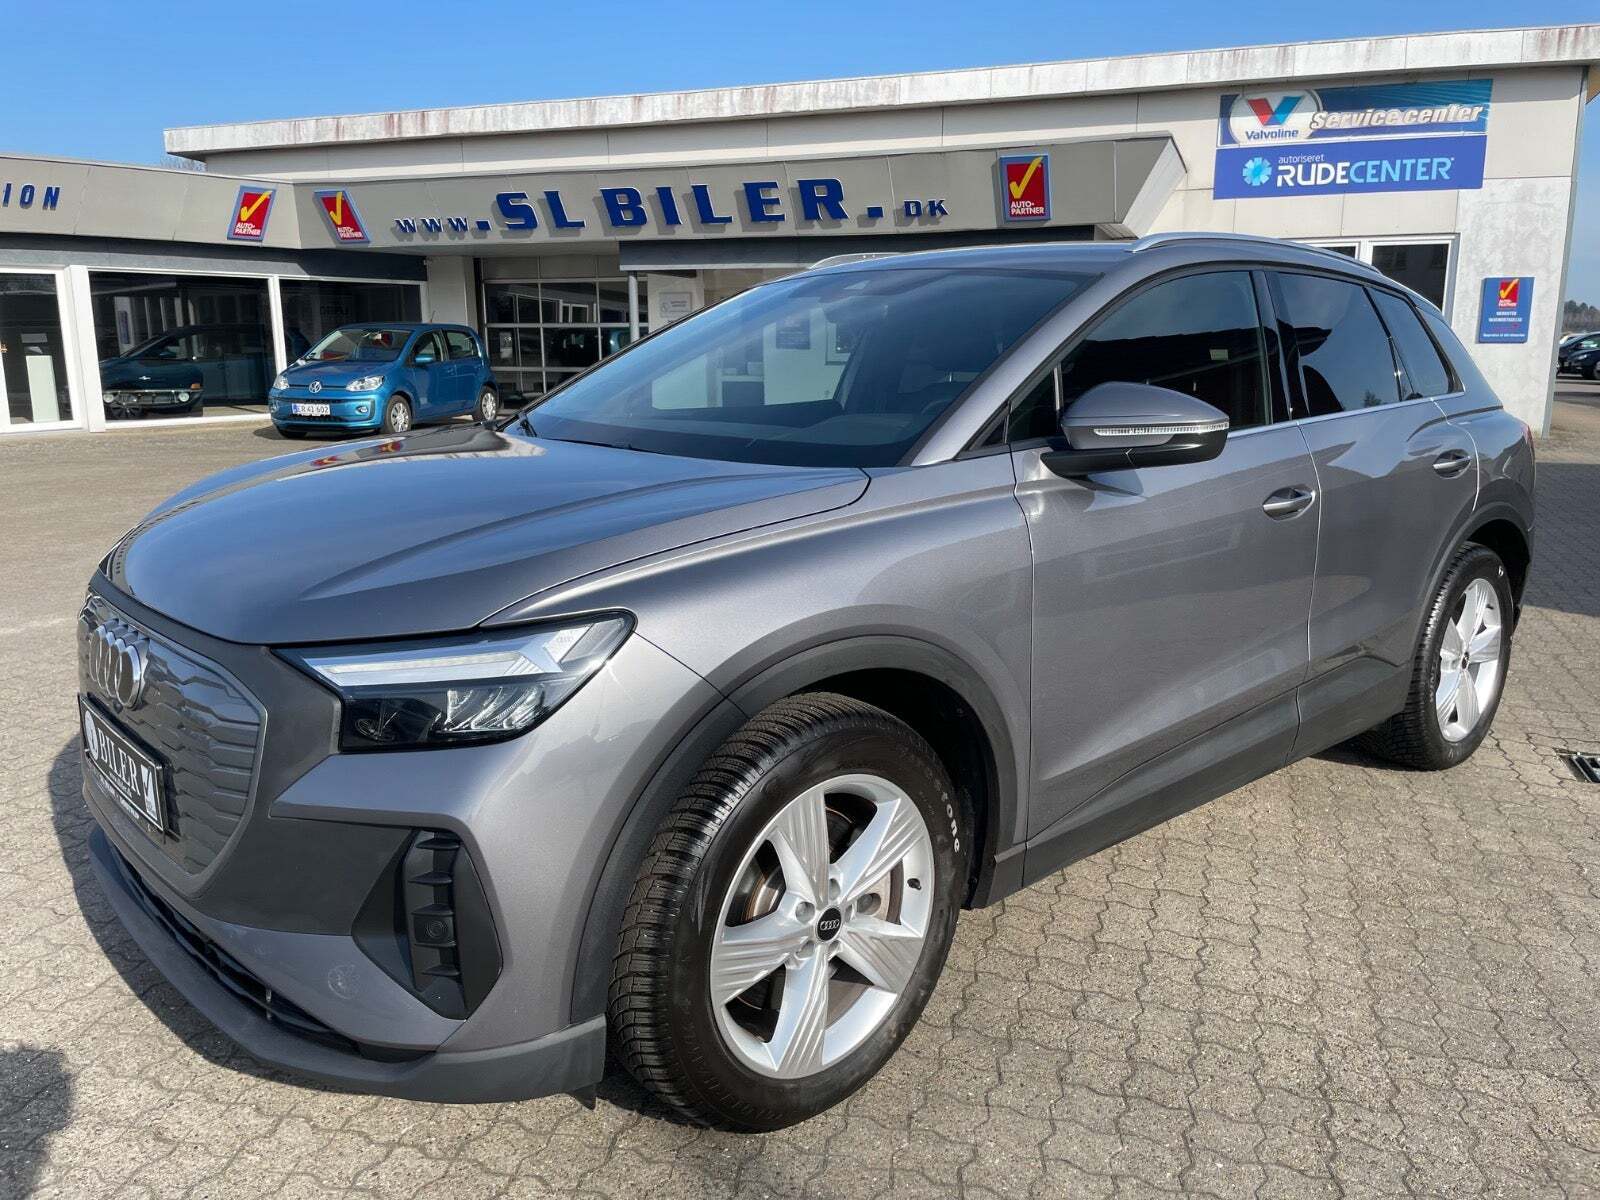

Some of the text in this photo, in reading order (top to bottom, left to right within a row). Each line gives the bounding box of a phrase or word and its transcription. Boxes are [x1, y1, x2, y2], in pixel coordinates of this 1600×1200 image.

[1245, 128, 1299, 140] Valvoline
[1278, 153, 1324, 164] autoriseret
[1010, 207, 1045, 216] PARTNER
[234, 228, 262, 236] PARTNER
[97, 727, 141, 797] BILER
